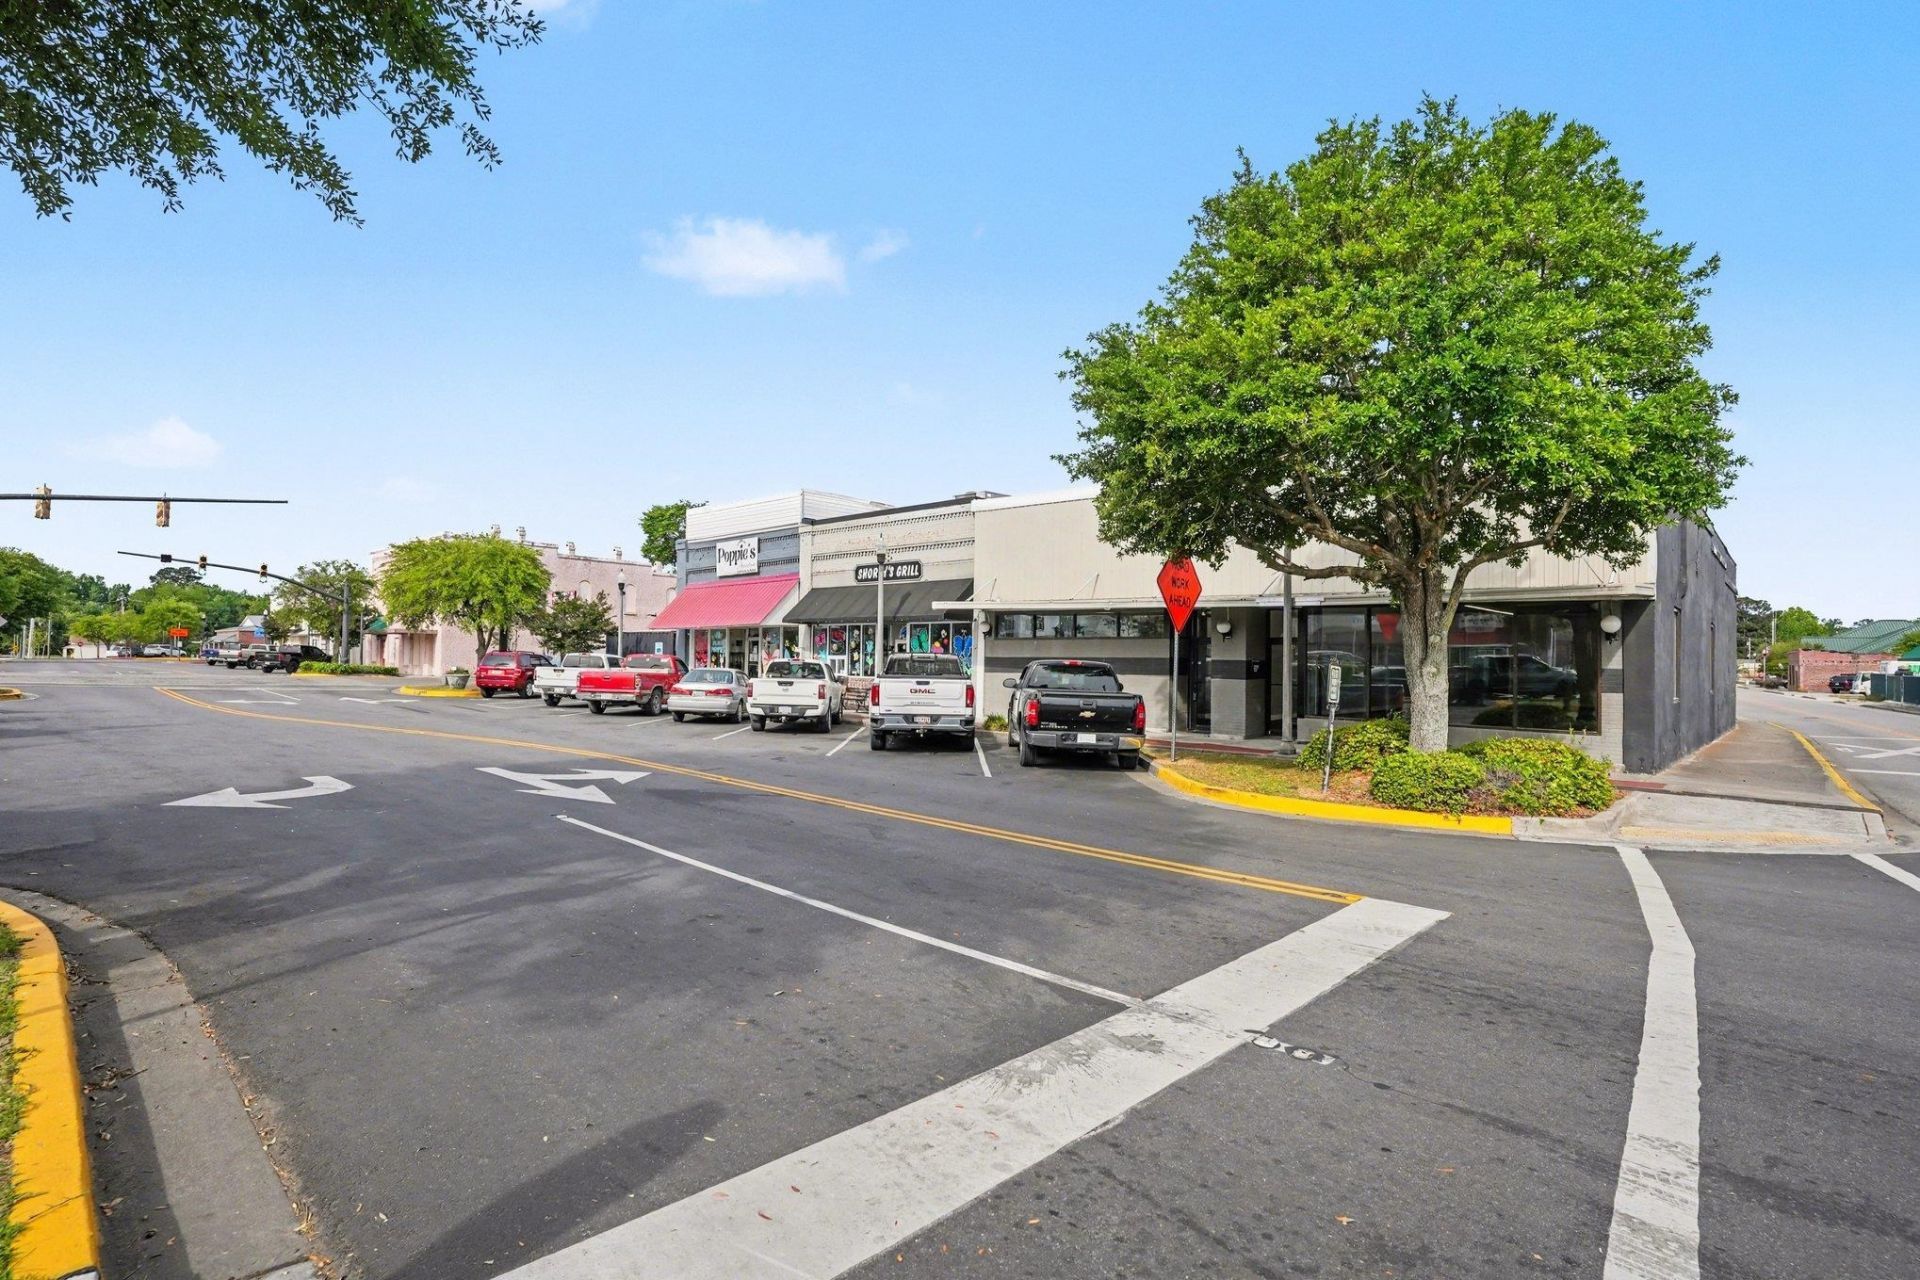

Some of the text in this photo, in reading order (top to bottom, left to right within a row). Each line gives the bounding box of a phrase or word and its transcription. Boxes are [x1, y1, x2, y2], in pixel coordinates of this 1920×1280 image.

[718, 543, 756, 566] Poppie's
[857, 564, 919, 580] SHORY'S GRILL
[1171, 576, 1190, 590] WORK
[1169, 594, 1191, 608] AHEAD
